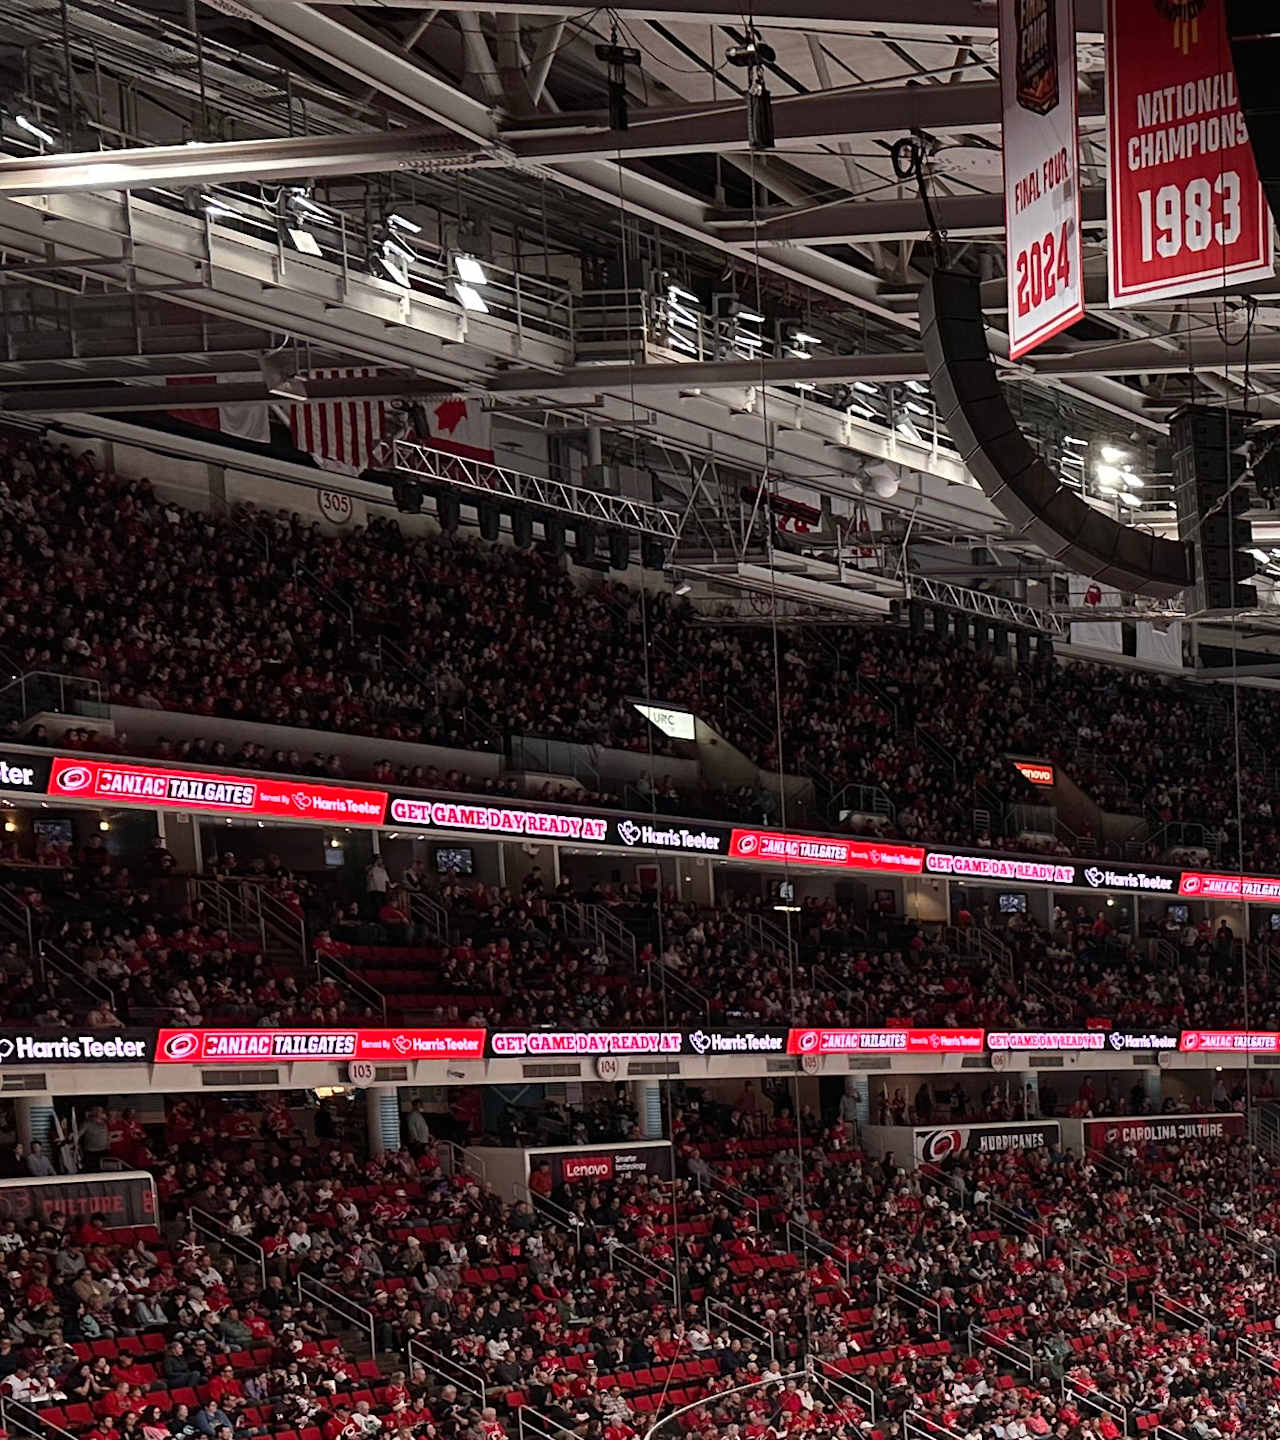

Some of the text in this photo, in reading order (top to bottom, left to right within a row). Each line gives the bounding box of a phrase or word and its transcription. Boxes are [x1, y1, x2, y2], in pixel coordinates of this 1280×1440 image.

[1137, 72, 1238, 129] NATIONAL
[1128, 112, 1249, 172] CHAMPIONS
[1014, 148, 1069, 215] FINAL FOUR
[1138, 171, 1241, 262] 1983
[1016, 217, 1070, 317] 2024
[100, 773, 253, 805] CANIAC TAILGATES
[391, 800, 607, 840] GET GAME DAY READY AT
[641, 826, 720, 850] Harris Teeter
[1105, 872, 1172, 890] Harris Teeter
[17, 1037, 145, 1057] Harris Teeter
[206, 1036, 354, 1055] CANIAC TAILGATES
[491, 1034, 682, 1054] GET GAME DAY READY AT
[712, 1034, 782, 1050] Harris Teeter
[352, 1064, 372, 1079] 103
[600, 1060, 616, 1073] 104
[979, 1134, 1044, 1151] HURRICANES
[1123, 1124, 1223, 1141] CAROLINA CULTURE
[567, 1164, 608, 1176] Lenovo
[44, 1196, 124, 1213] CULTURE
